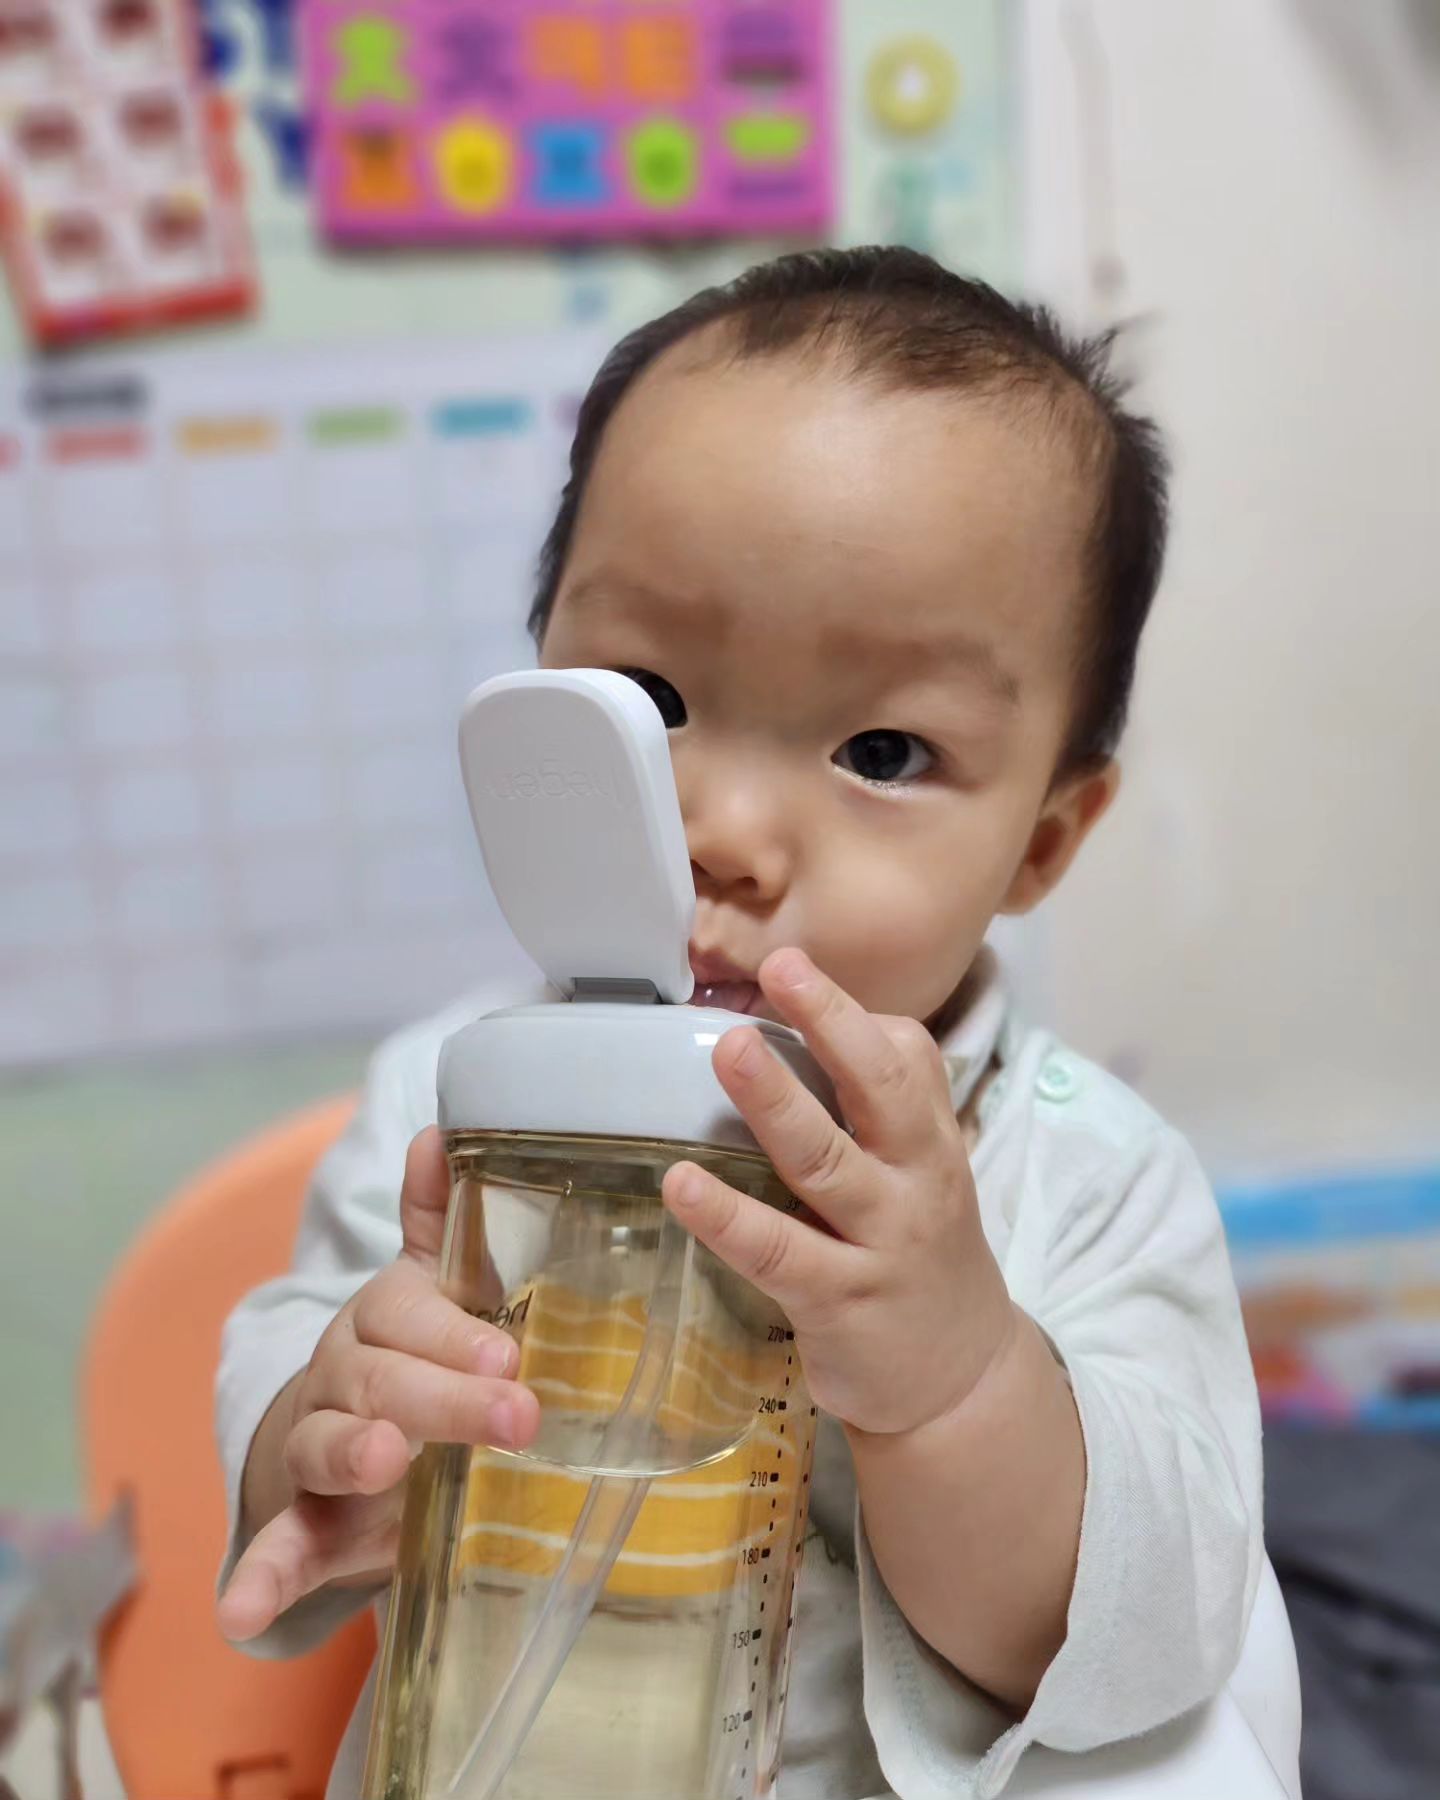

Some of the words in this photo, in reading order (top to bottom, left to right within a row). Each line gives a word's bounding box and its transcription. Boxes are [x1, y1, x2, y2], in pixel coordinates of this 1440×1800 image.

[767, 1326, 785, 1343] 270
[758, 1397, 777, 1414] 240
[749, 1471, 768, 1488] 210
[741, 1548, 760, 1565] 180
[732, 1630, 751, 1649] 150
[722, 1714, 741, 1734] 120
